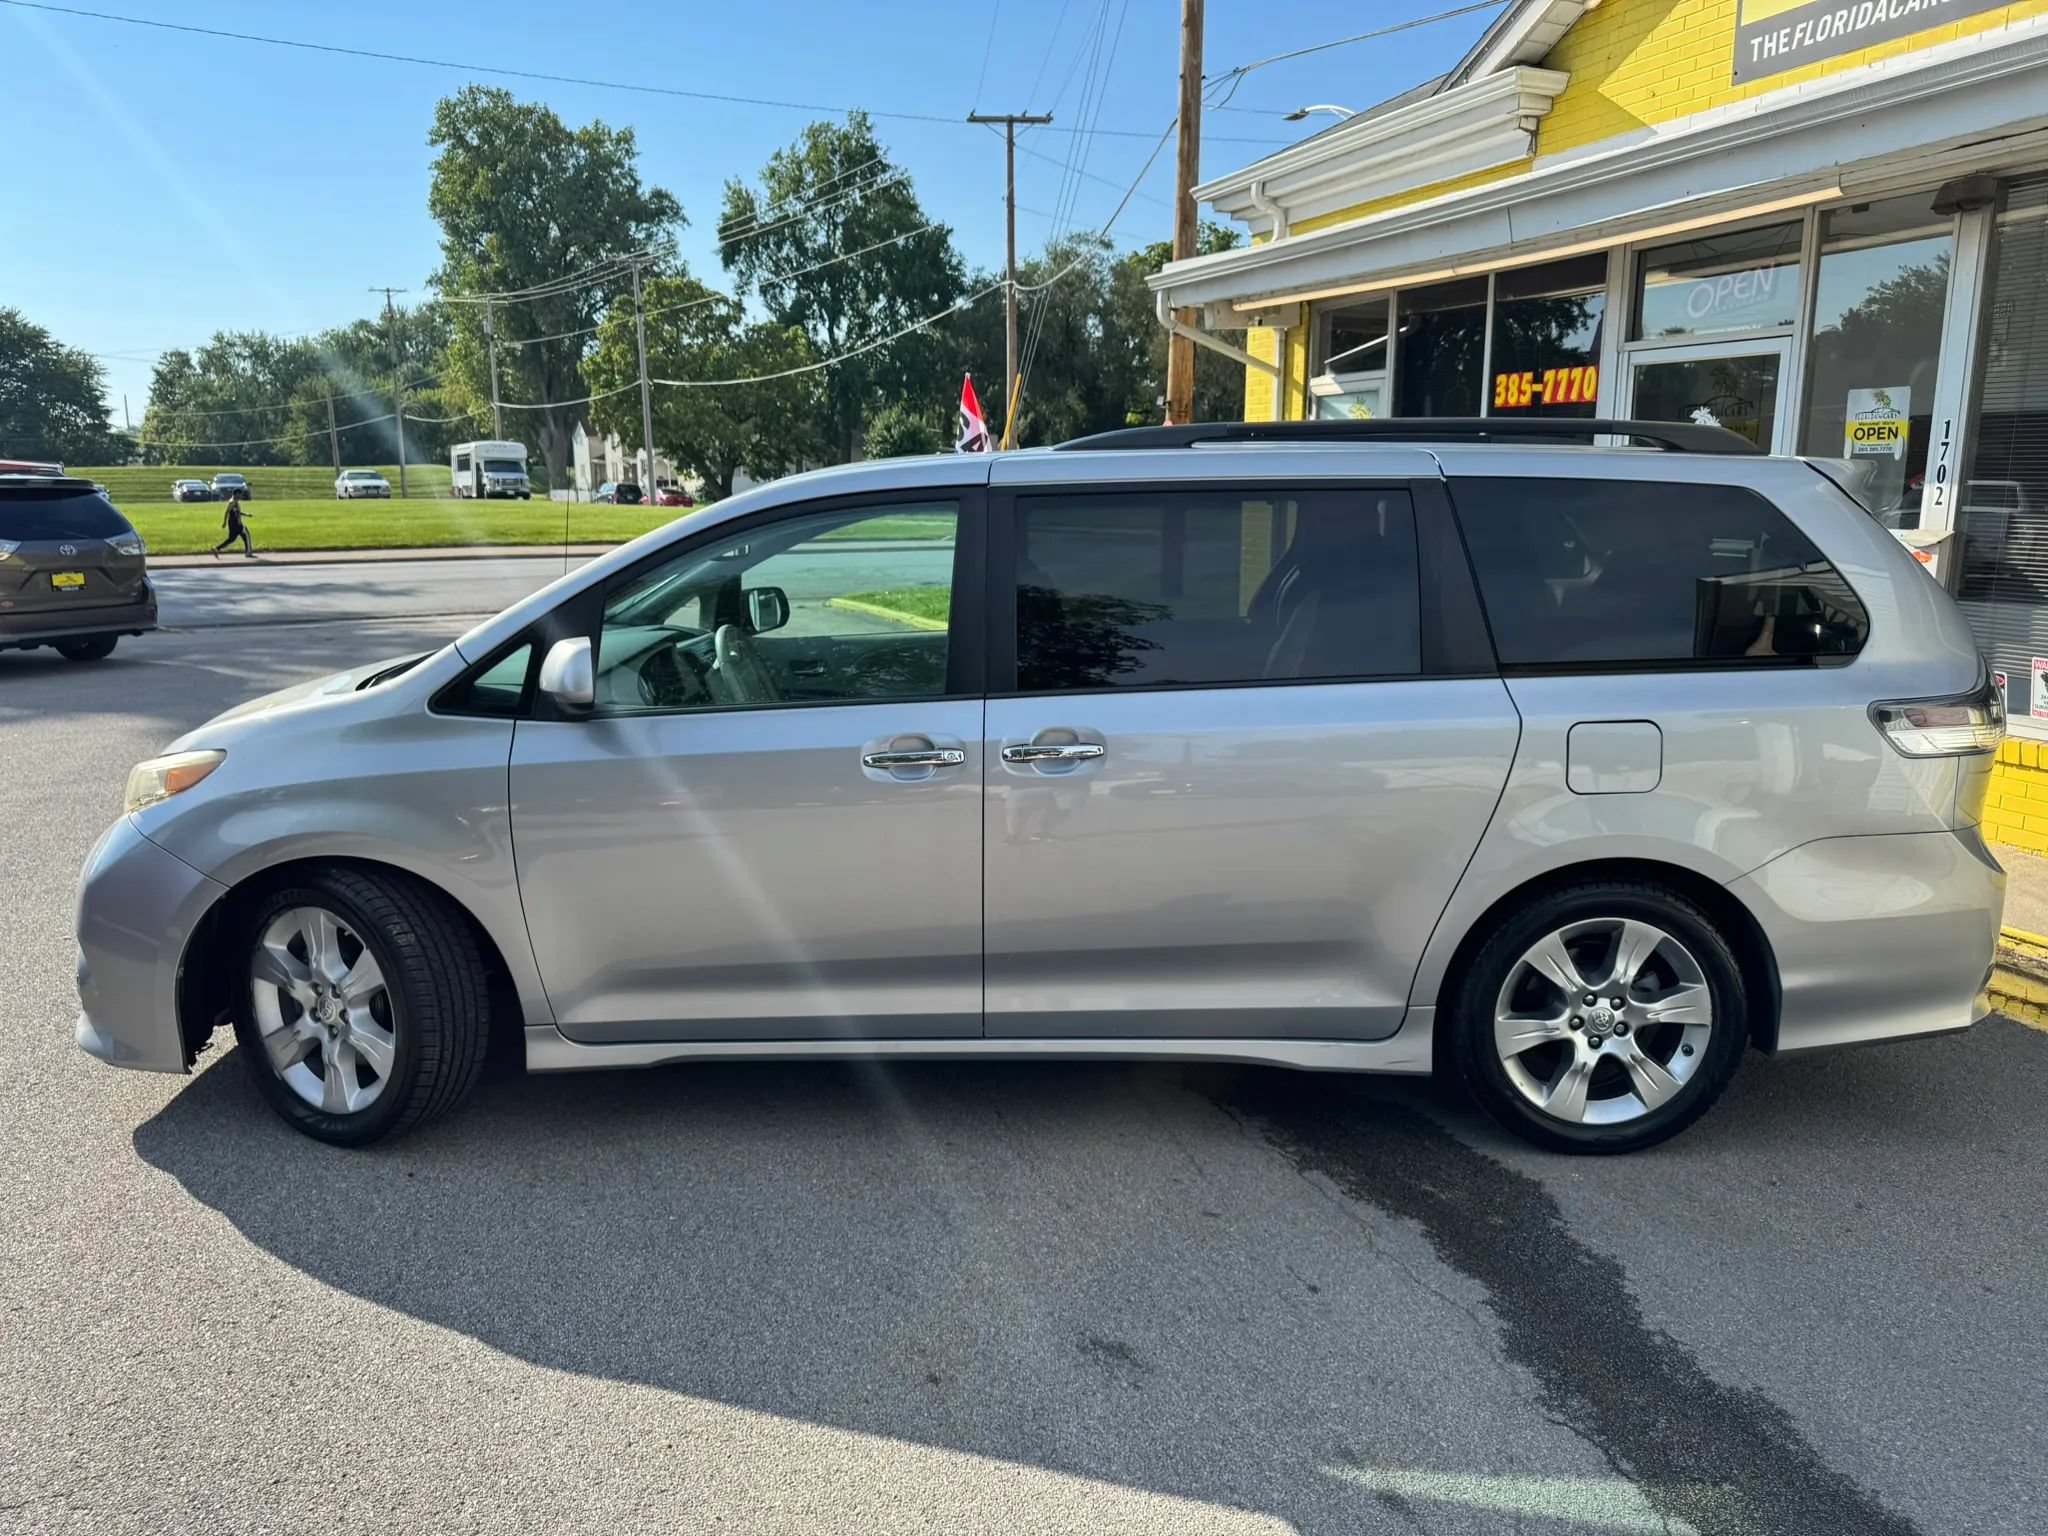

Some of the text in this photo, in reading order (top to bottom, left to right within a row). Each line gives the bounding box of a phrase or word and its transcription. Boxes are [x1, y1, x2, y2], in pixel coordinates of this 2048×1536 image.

[1688, 264, 1775, 318] OPEN
[1494, 366, 1597, 407] 385-7770
[1854, 426, 1899, 440] OPEN
[1934, 419, 1951, 505] 1702
